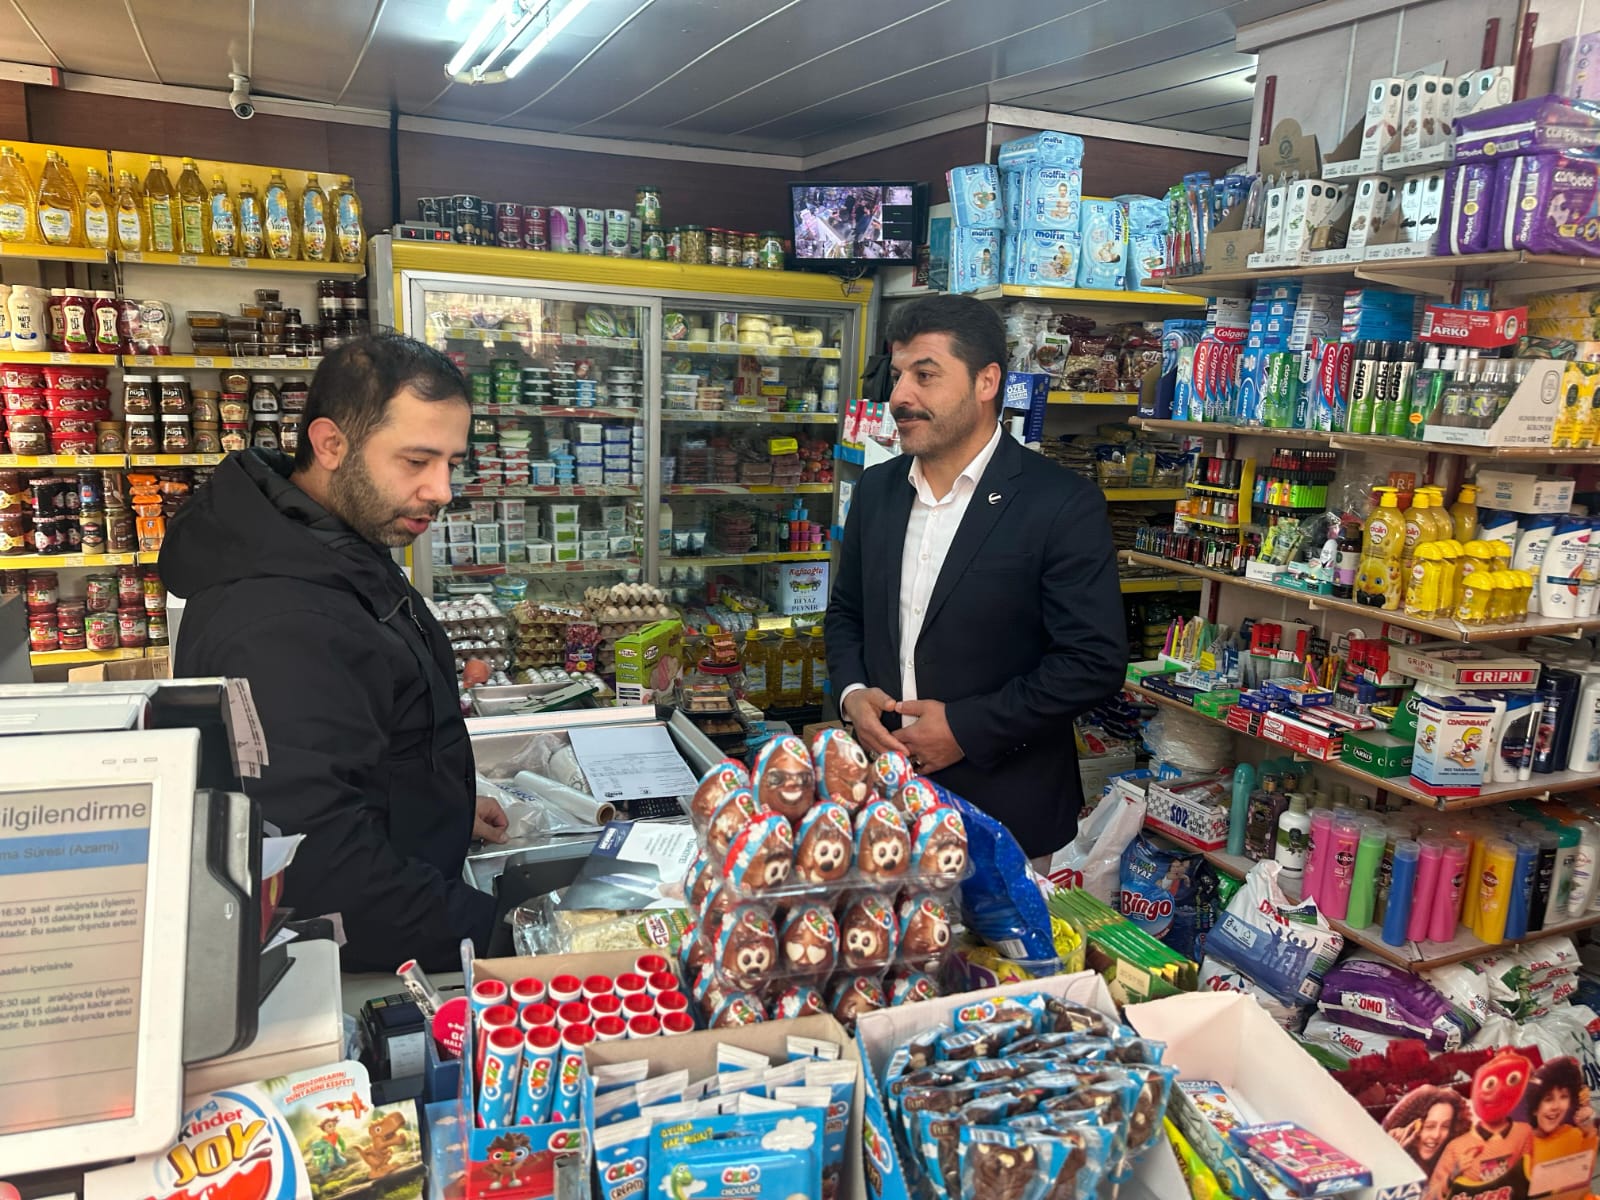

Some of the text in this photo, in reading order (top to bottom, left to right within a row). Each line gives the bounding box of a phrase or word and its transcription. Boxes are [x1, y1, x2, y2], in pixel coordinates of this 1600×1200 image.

[1040, 169, 1066, 180] molfix
[1034, 229, 1065, 240] molfix
[1216, 328, 1248, 339] Colgate
[1432, 326, 1469, 337] ARKO
[1197, 345, 1206, 391] Colgate
[1209, 346, 1219, 387] Colgate
[1325, 346, 1336, 397] Colgate
[1353, 362, 1367, 400] Gibbs
[1376, 364, 1389, 400] Gibbs
[1389, 363, 1403, 401] Gibbs
[784, 739, 811, 766] OZM
[2, 801, 146, 831] ilgilendirme
[877, 807, 905, 829] OZM
[1121, 891, 1172, 922] Bingo
[959, 1003, 994, 1022] OZMO
[1358, 996, 1383, 1014] OMO
[1340, 1033, 1364, 1053] OMO
[484, 1057, 502, 1099] OZMO
[530, 1059, 550, 1098] OZMO
[562, 1055, 582, 1096] OZMO
[167, 1119, 267, 1187] JOY
[606, 1158, 646, 1182] OZMO
[722, 1166, 760, 1182] OZMO
